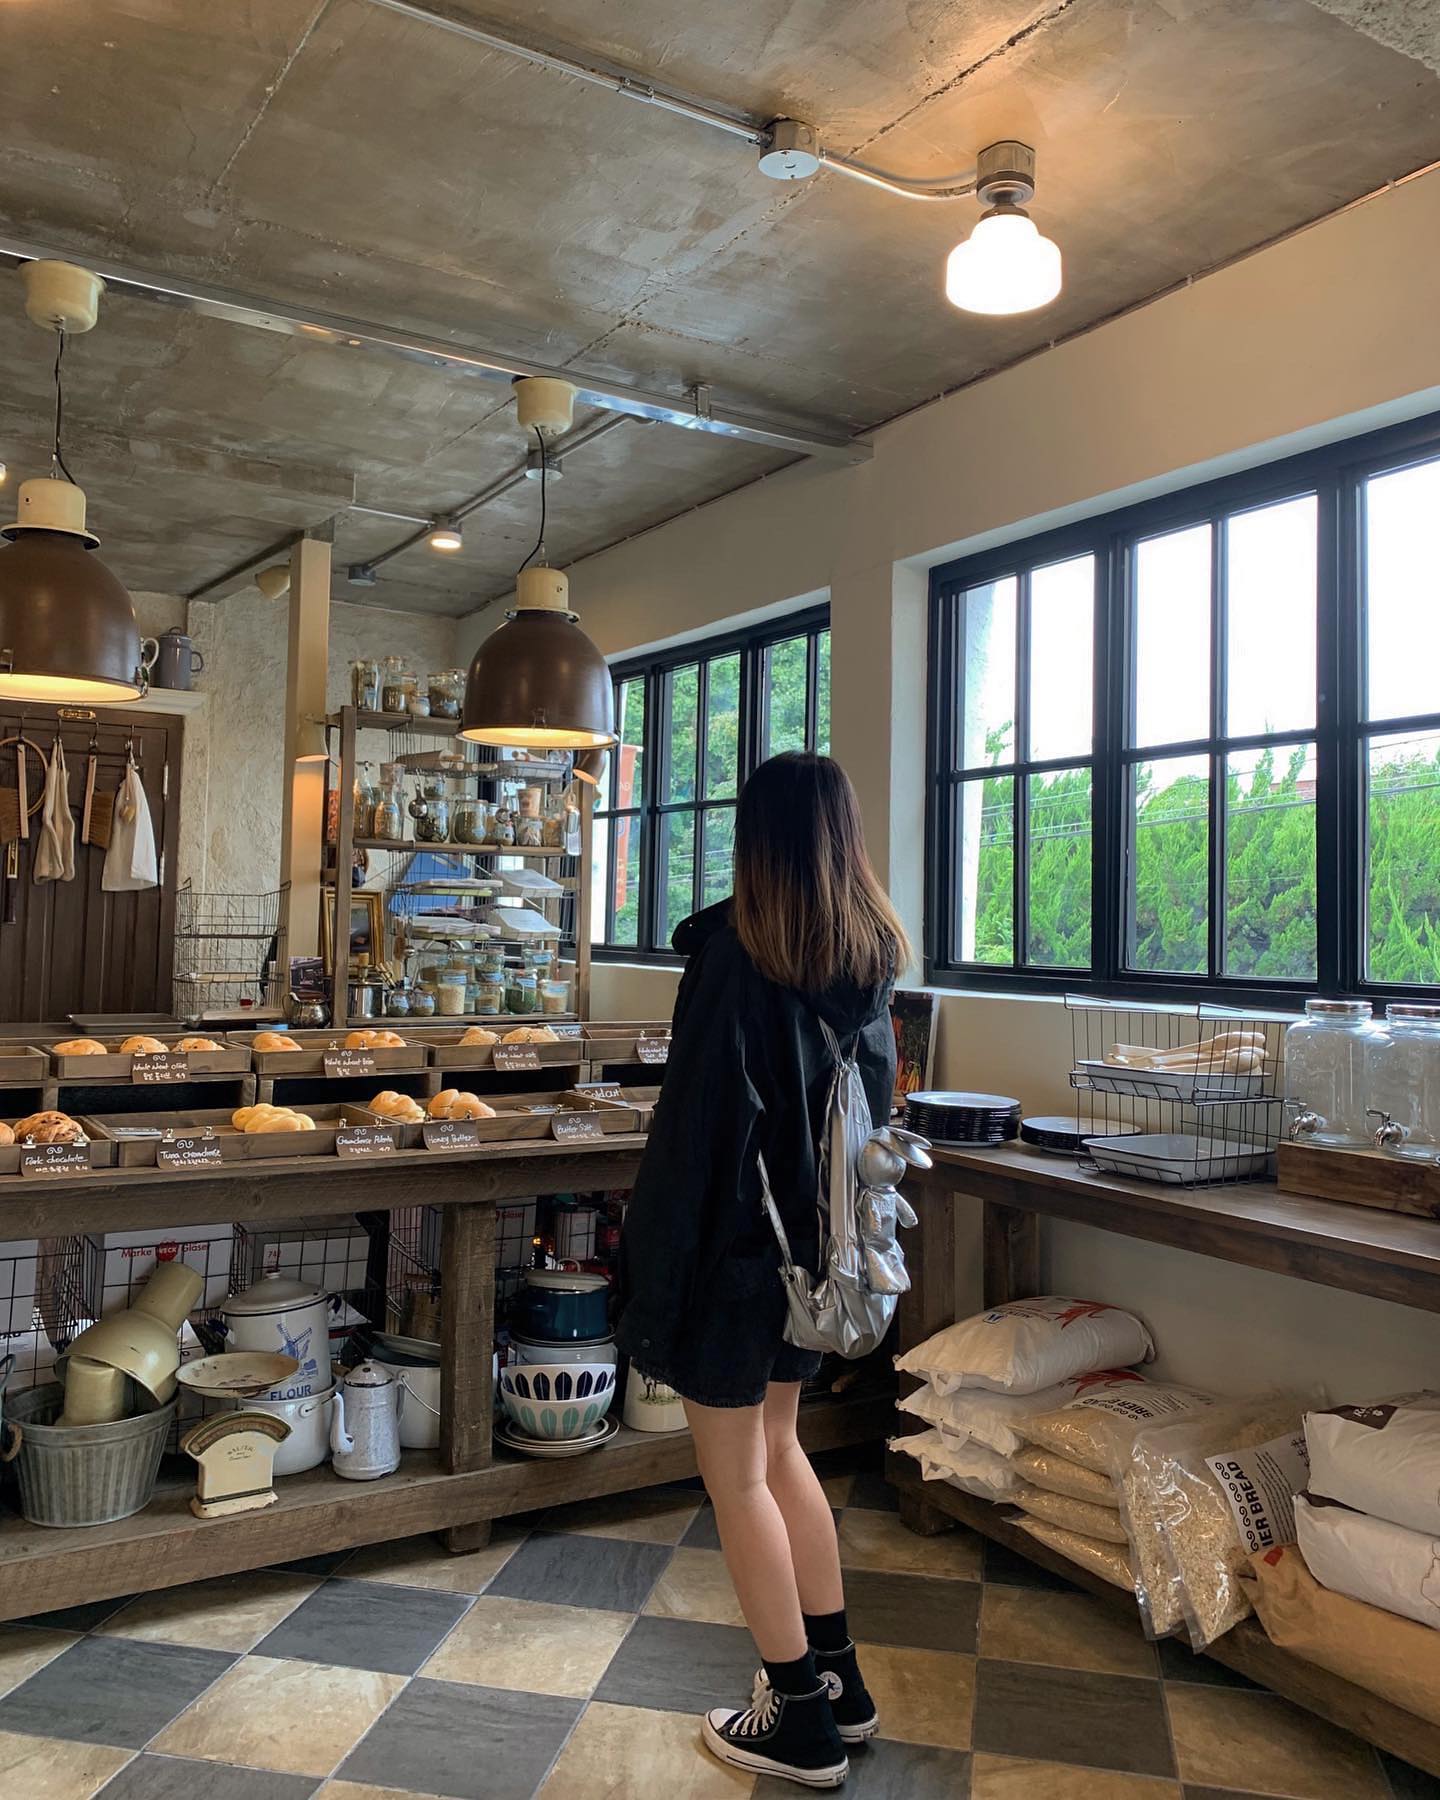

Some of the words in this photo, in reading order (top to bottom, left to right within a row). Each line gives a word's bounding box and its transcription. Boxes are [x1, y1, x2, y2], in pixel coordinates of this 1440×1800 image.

[160, 1150, 180, 1160] Tuna
[121, 1247, 152, 1259] Marke
[270, 1384, 312, 1401] FLOUR
[1226, 1461, 1264, 1515] BREAD
[1255, 1517, 1274, 1547] IER
